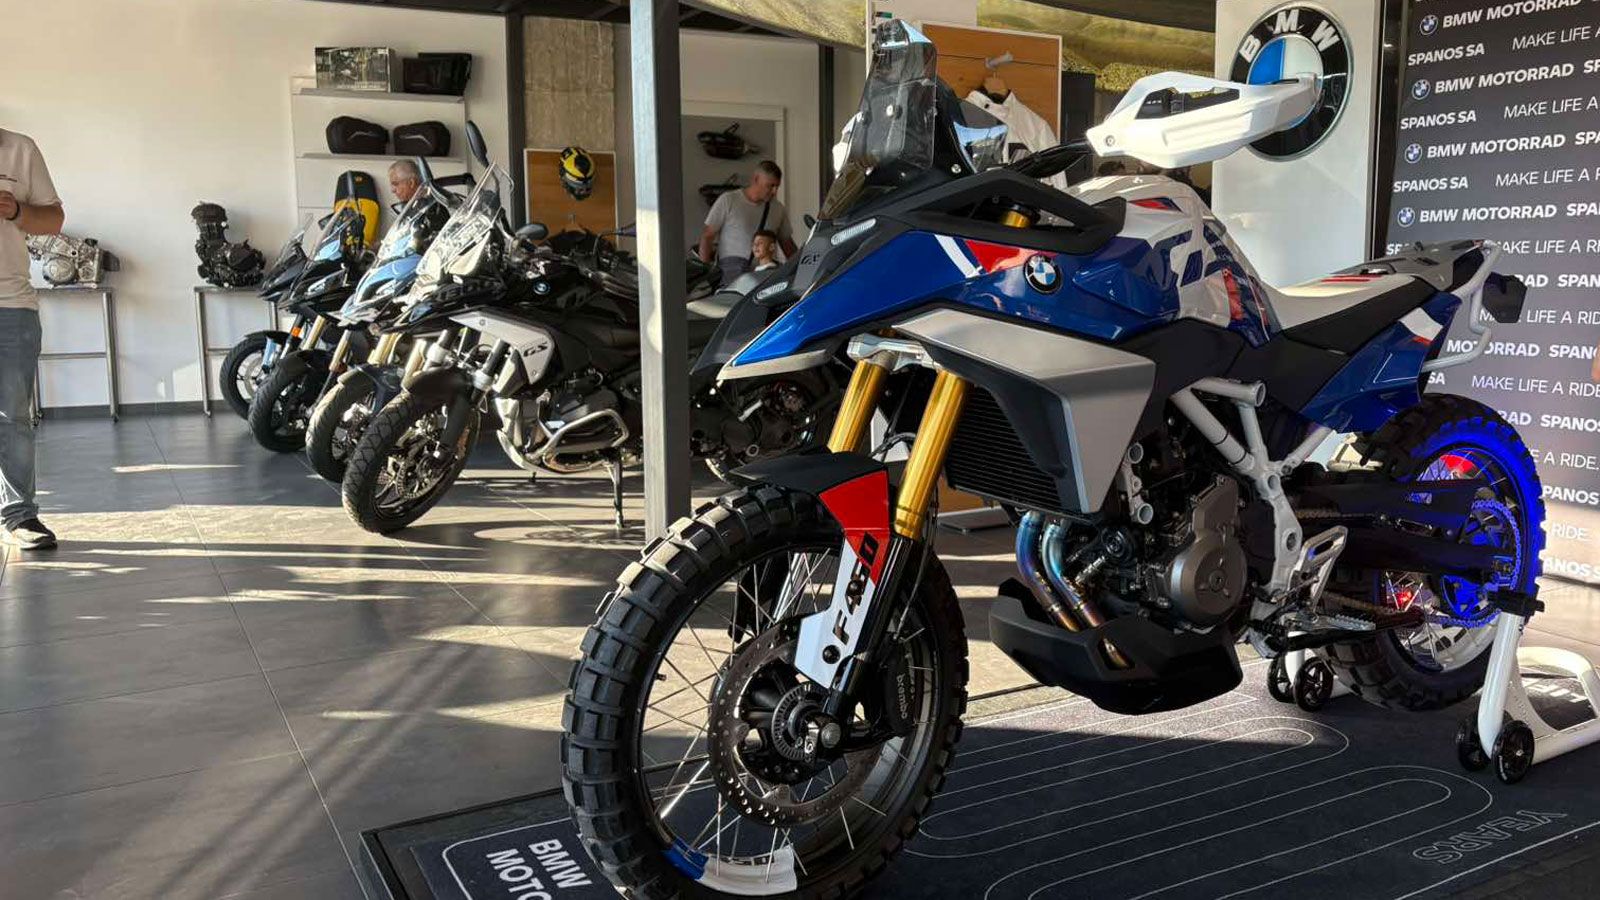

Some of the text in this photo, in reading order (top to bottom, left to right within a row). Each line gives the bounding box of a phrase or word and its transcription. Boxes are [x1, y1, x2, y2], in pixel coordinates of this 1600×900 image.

[1442, 9, 1483, 29] BMW
[1239, 8, 1340, 63] BMW
[1512, 31, 1556, 50] MAKE
[1560, 26, 1591, 43] LIFE
[1408, 43, 1485, 66] SPANOS SA
[1434, 63, 1574, 94] BMW MOTORRAD
[1503, 96, 1598, 119] MAKE LIFE A
[1400, 110, 1477, 130] SPANOS SA
[1427, 134, 1566, 159] BMW MOTORRAD
[1393, 176, 1468, 193] SPANOS SA
[1495, 171, 1539, 187] MAKE
[1543, 169, 1574, 183] LIFE
[1577, 168, 1590, 181] A
[1419, 204, 1557, 223] BMW MOTORRAD
[1500, 240, 1535, 254] AKE
[1535, 240, 1566, 254] LIFE
[1569, 240, 1581, 253] A
[1526, 309, 1557, 324] LIFE
[1560, 311, 1573, 324] A
[1471, 375, 1514, 391] MAKE
[1518, 378, 1548, 393] LIFE
[1552, 381, 1564, 395] A
[1543, 453, 1555, 465] A
[1560, 453, 1600, 470] RIDE.
[1540, 484, 1599, 505] PANOS
[896, 673, 908, 719] brembo
[1412, 809, 1568, 864] YEARS
[528, 838, 593, 888] BMW
